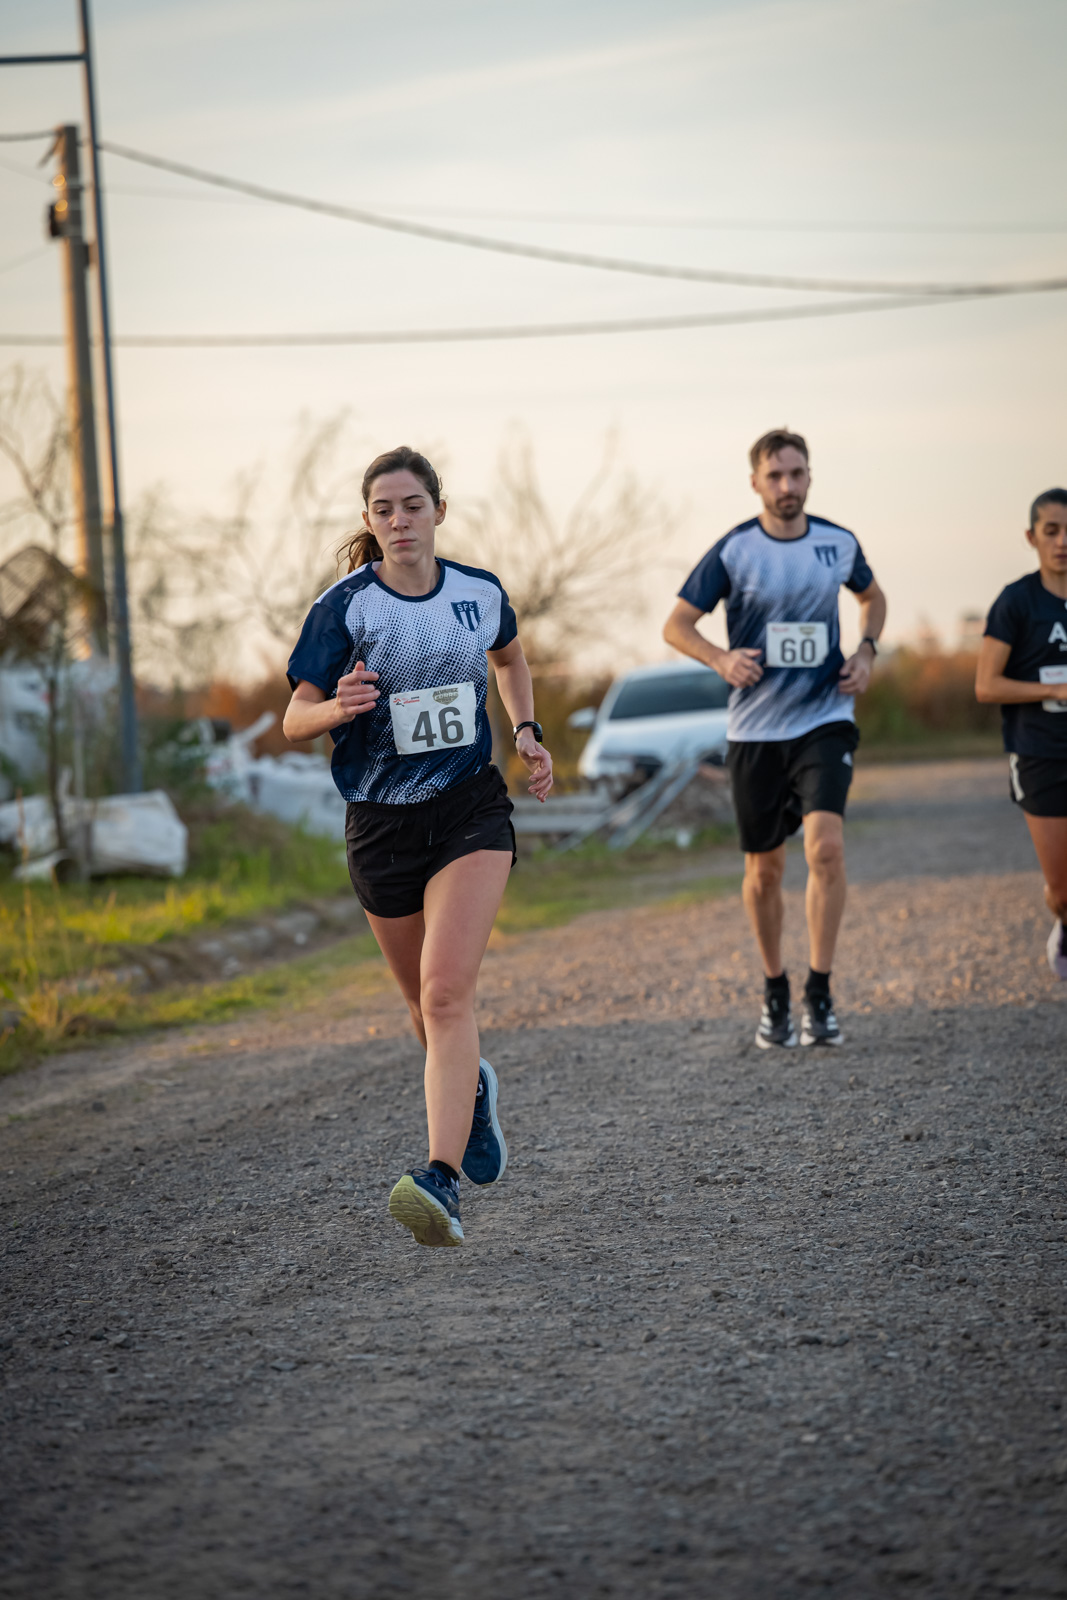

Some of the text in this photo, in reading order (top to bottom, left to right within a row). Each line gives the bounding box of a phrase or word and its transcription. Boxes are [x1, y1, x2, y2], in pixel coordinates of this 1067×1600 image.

[457, 603, 475, 612] SFC
[781, 638, 816, 664] 60
[412, 706, 464, 748] 46
